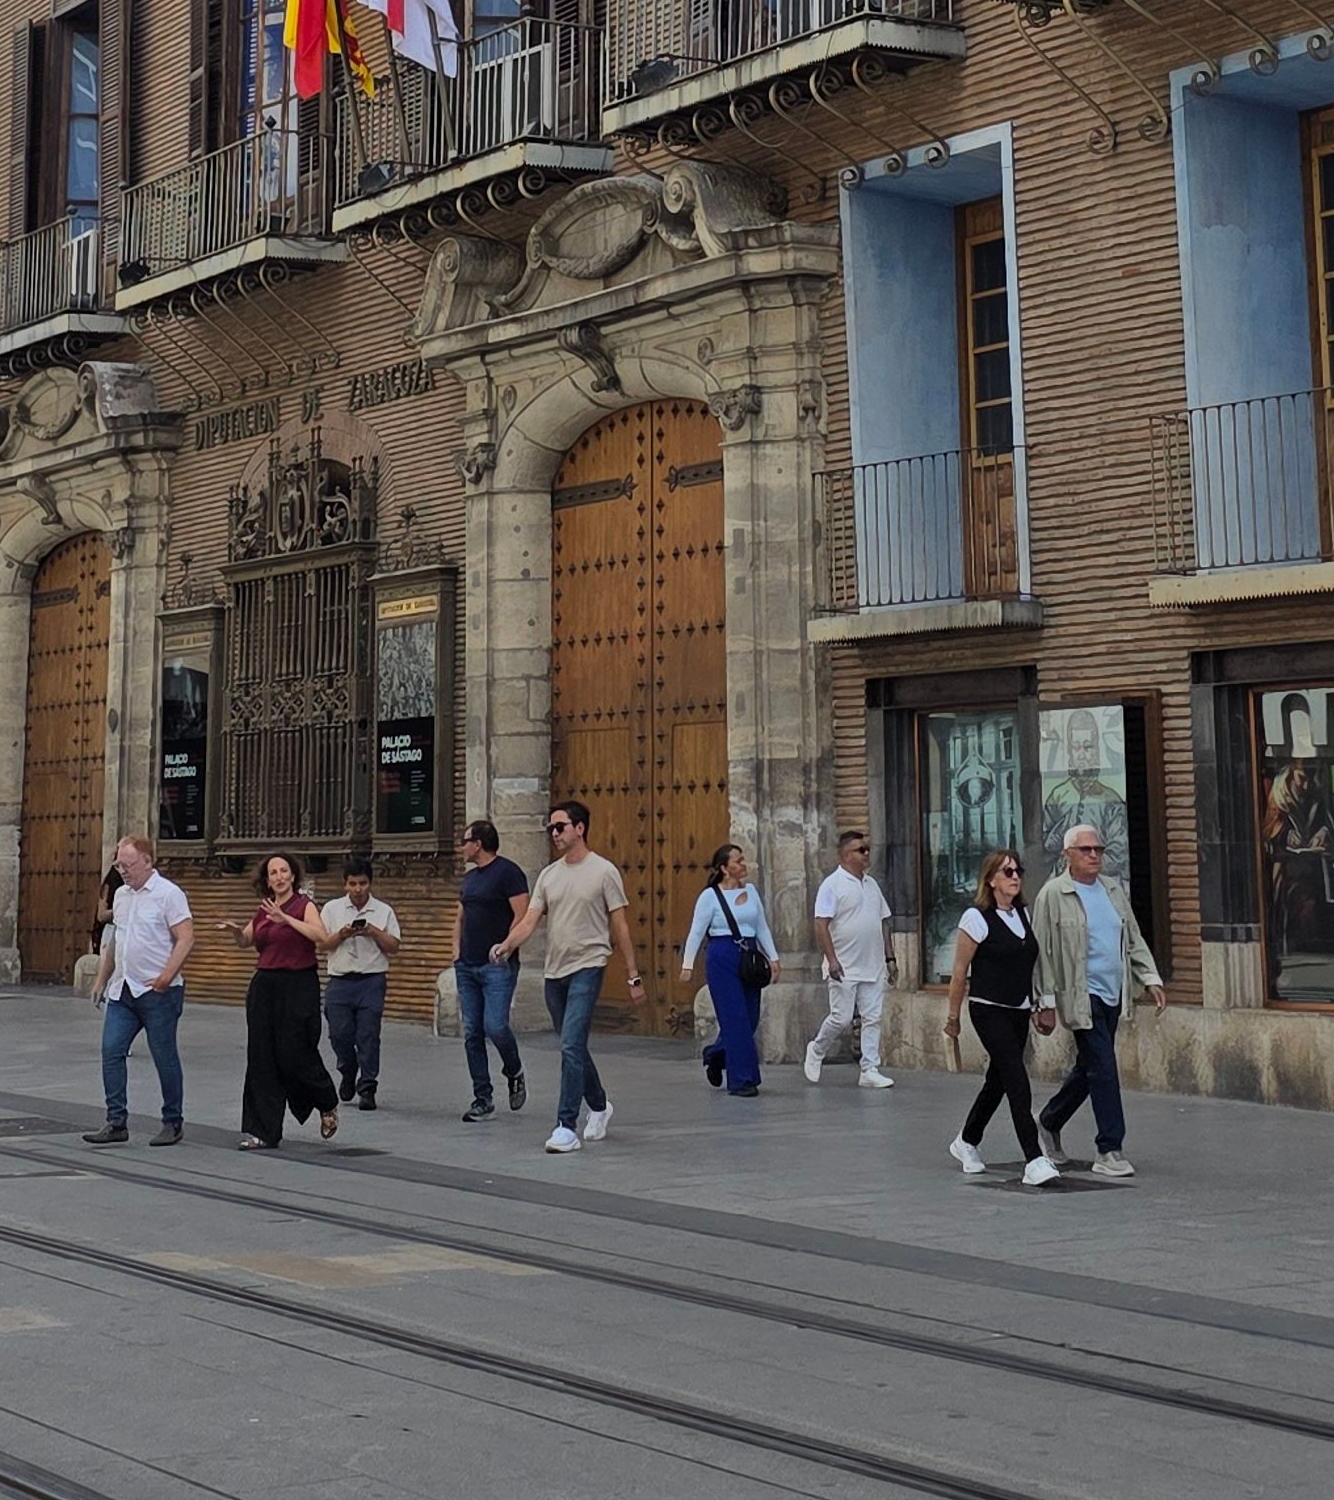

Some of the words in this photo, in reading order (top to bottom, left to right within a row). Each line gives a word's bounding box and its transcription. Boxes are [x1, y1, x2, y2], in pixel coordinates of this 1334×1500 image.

[300, 386, 324, 424] DE
[347, 357, 435, 412] ZARAGOZA
[381, 734, 412, 749] PALACIO
